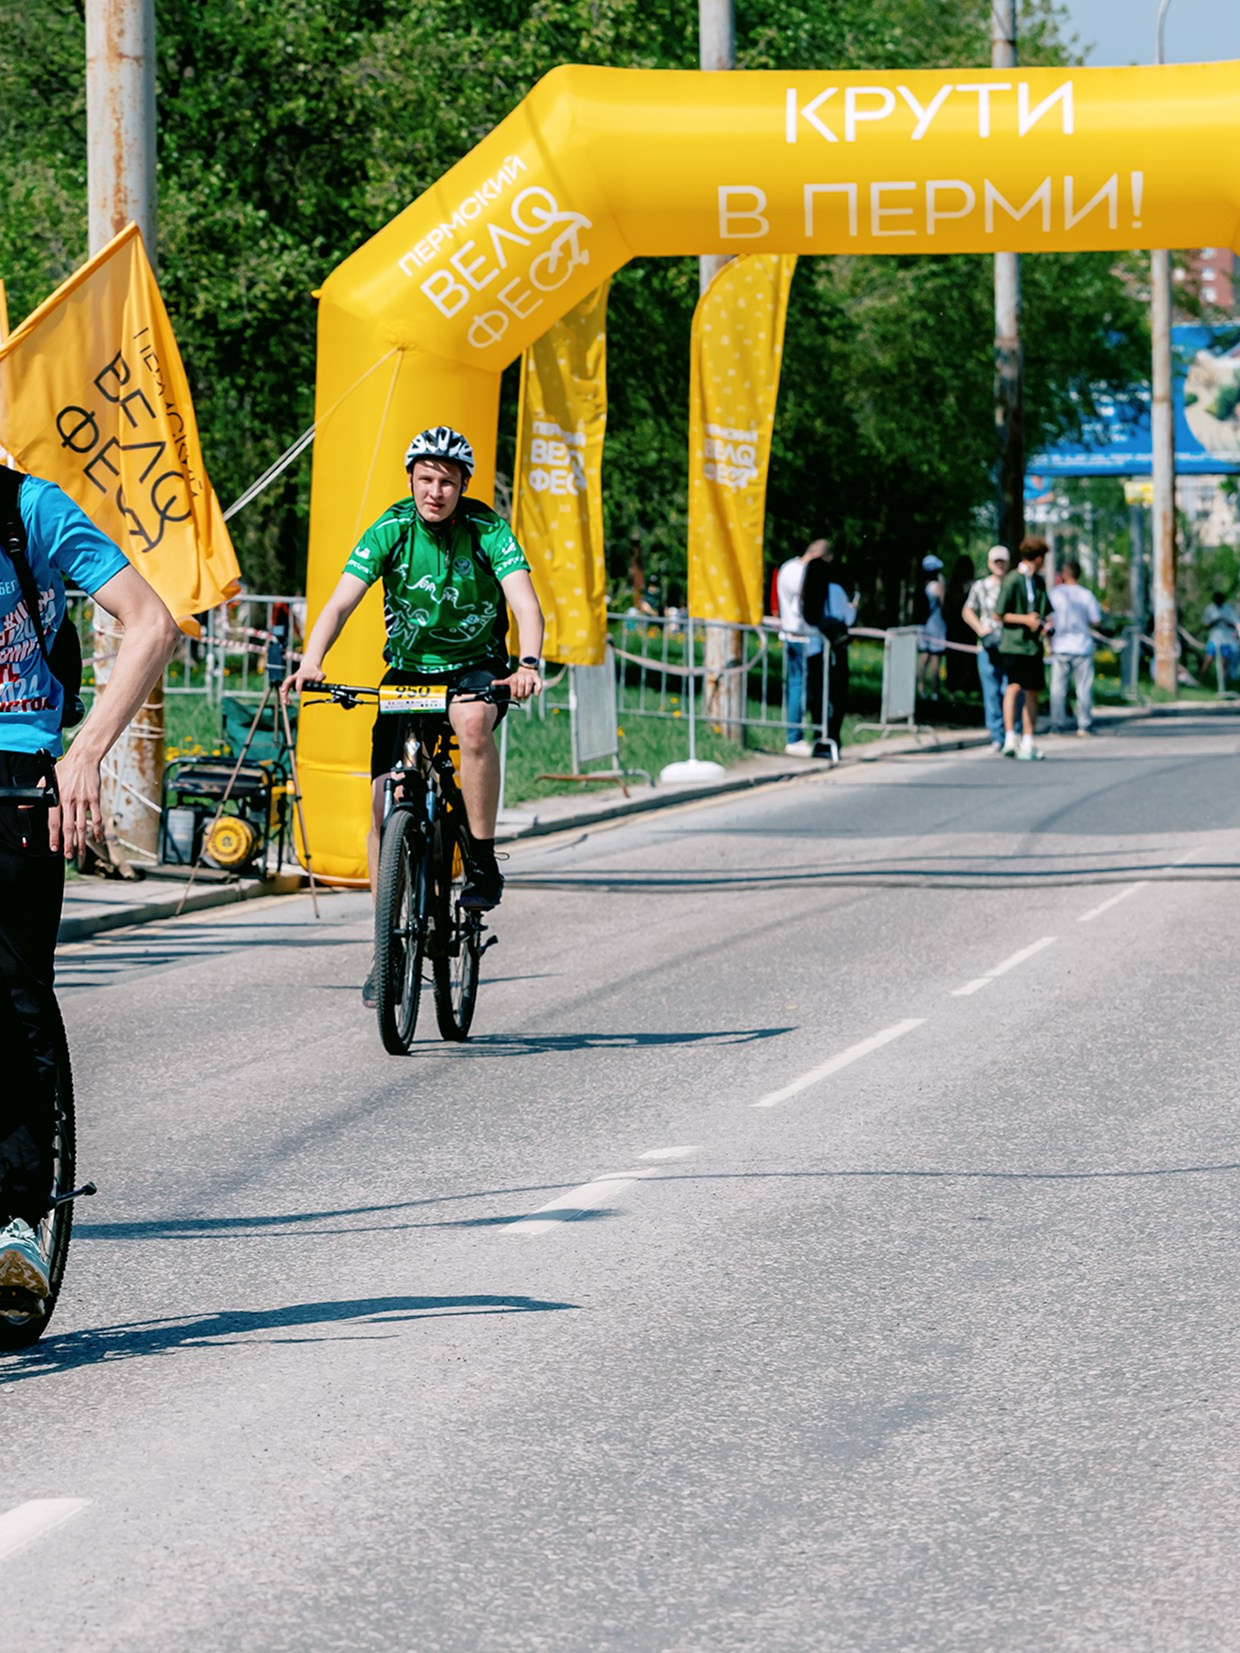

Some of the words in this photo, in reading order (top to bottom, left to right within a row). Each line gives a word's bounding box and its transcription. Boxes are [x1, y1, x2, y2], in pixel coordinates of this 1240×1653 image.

[785, 80, 1075, 143] КРУТИ
[398, 155, 528, 278] ПЕРМСКИЙ
[717, 185, 770, 240] В
[803, 170, 1144, 238] ПЕРМИ!
